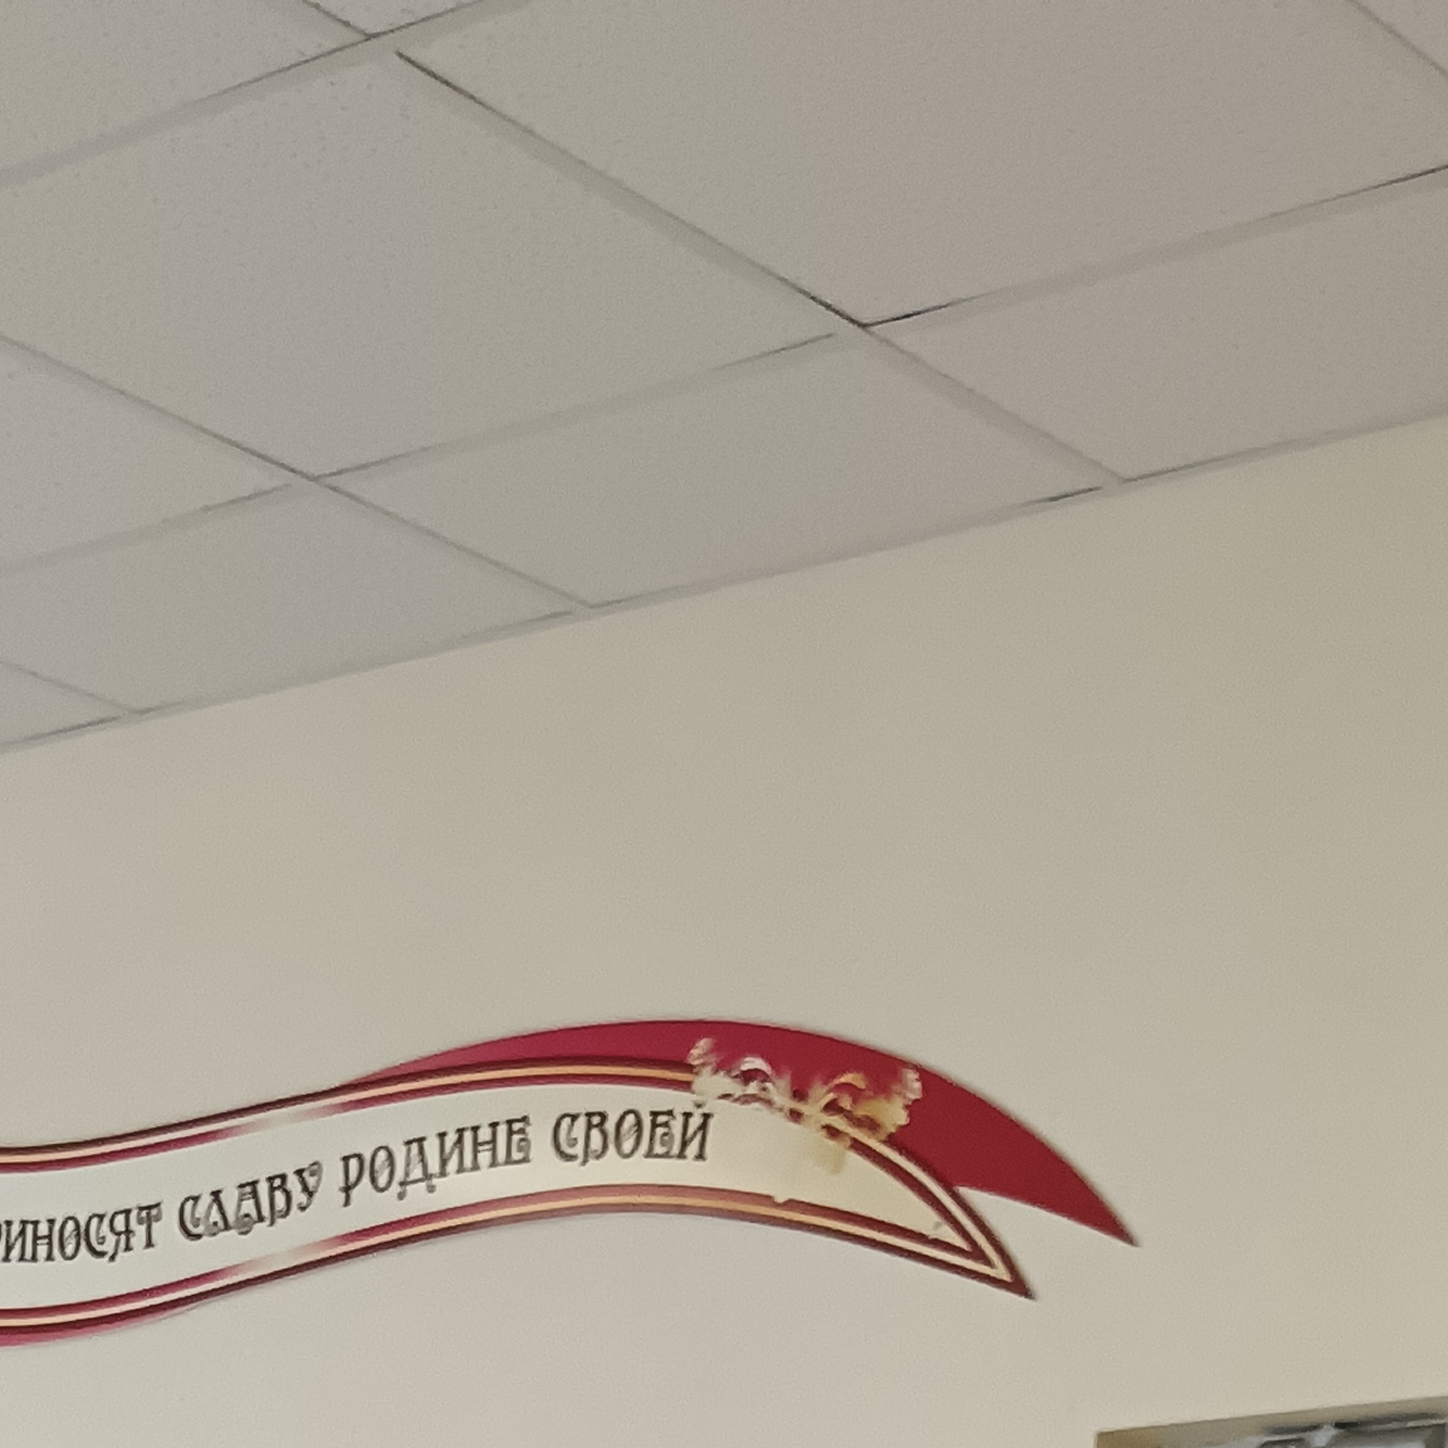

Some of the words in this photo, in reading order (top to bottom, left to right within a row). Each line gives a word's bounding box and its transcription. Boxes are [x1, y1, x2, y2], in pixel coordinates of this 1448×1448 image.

[178, 1161, 322, 1241] СЛАВУ
[339, 1115, 533, 1207] РОДИНЕ
[552, 1101, 714, 1166] СВОЕЙ
